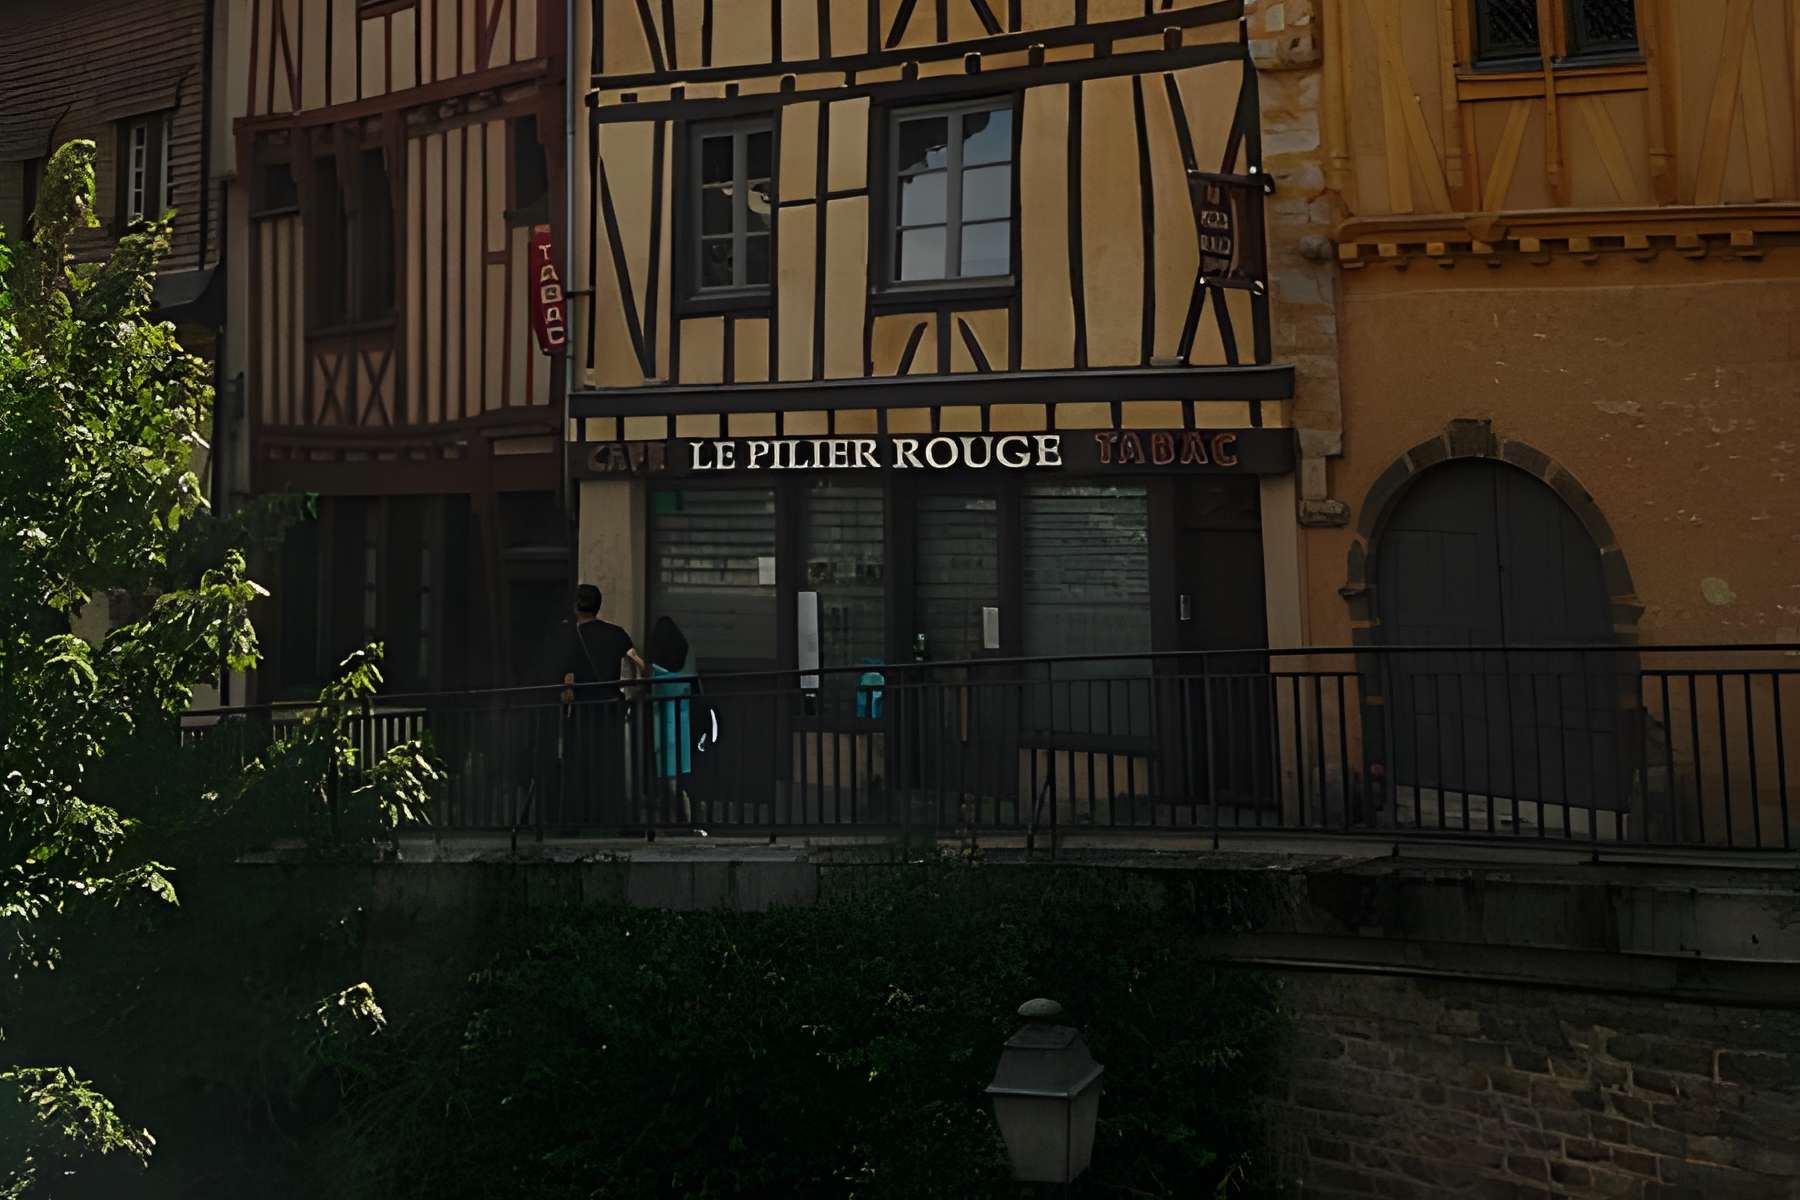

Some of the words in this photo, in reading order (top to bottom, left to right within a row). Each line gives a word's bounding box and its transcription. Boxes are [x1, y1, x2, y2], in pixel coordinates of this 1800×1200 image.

[538, 243, 566, 345] TABAC
[688, 440, 736, 470] LE
[746, 438, 881, 469] PILIER
[891, 434, 1063, 469] ROUGE
[1095, 430, 1239, 467] TABAC
